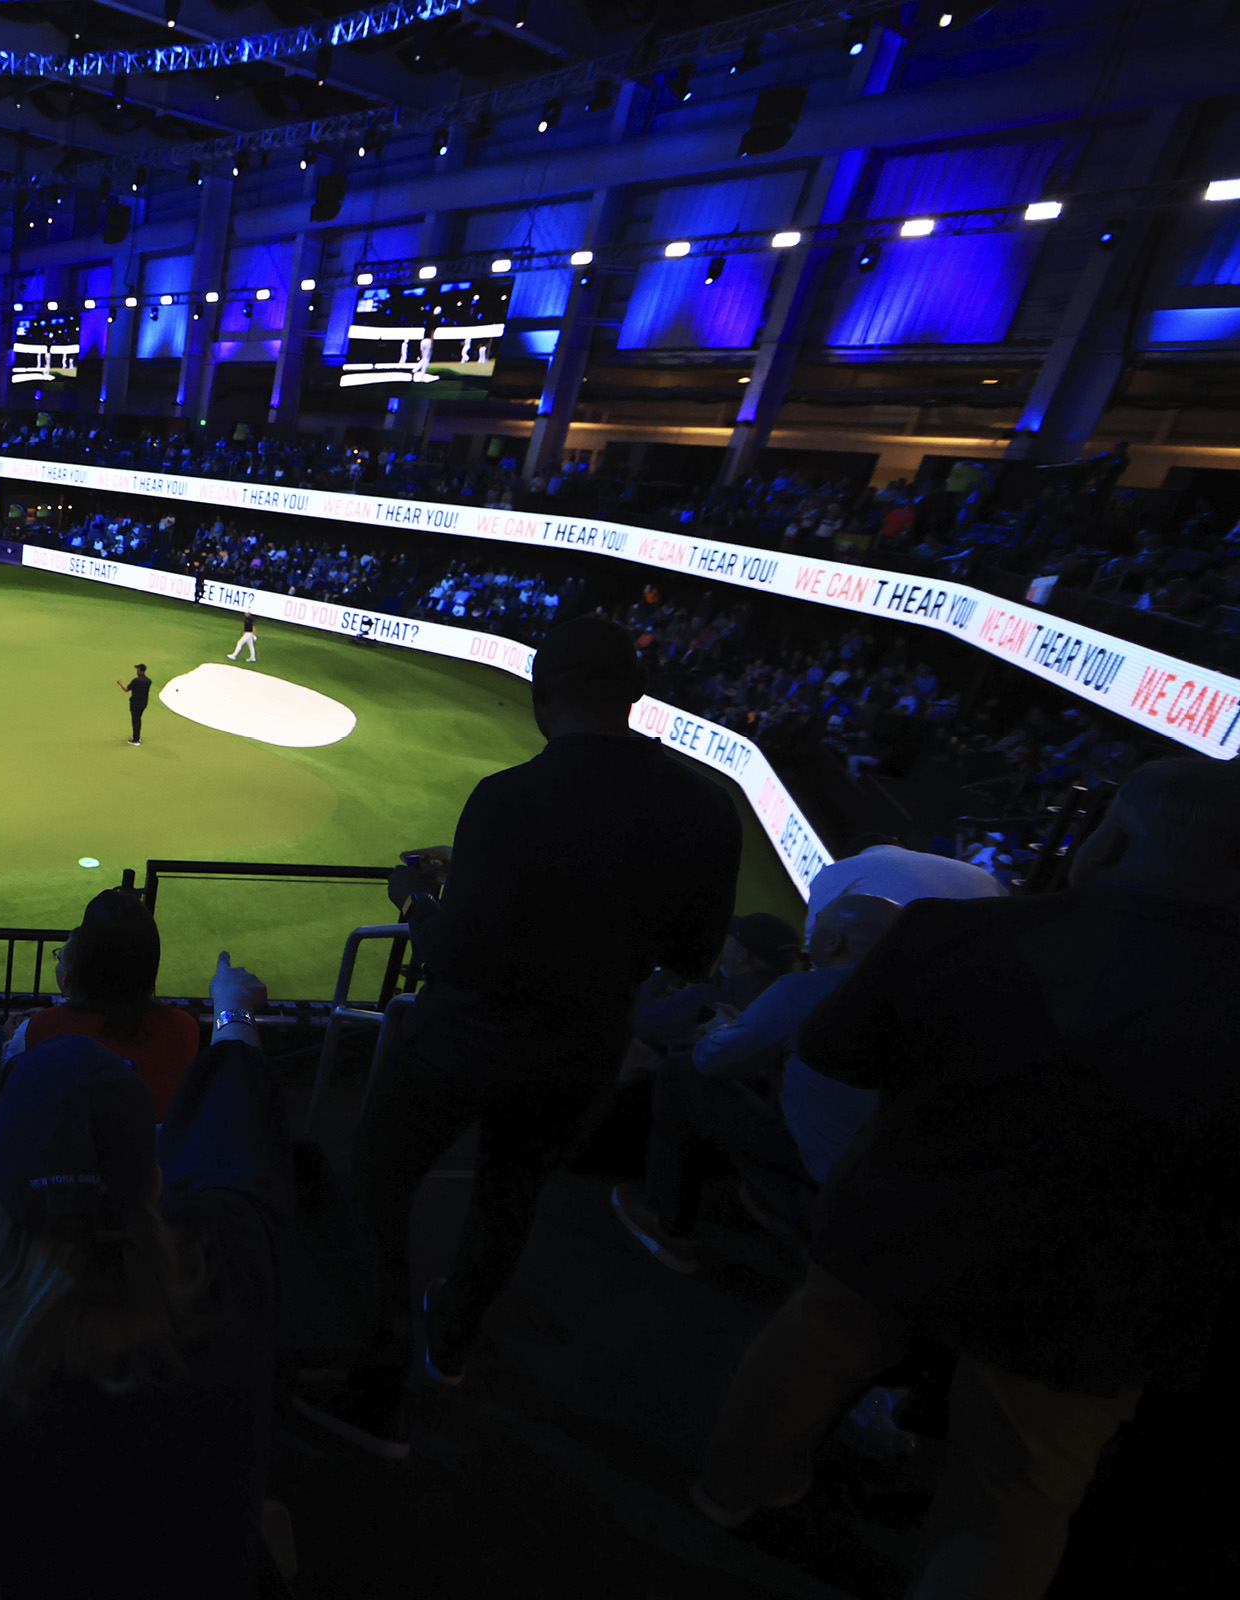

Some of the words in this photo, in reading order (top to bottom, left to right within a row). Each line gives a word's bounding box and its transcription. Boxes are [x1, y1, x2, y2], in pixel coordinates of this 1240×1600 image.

[139, 477, 164, 493] HEAR
[166, 479, 188, 497] YOU!
[249, 488, 280, 507] HEAR
[282, 492, 310, 512] YOU!
[322, 498, 342, 517] WE
[344, 501, 383, 520] CAN'T
[385, 504, 421, 525] HEAR
[426, 509, 460, 529] YOU!
[476, 514, 499, 535] WE
[503, 517, 552, 541] CAN'T
[554, 523, 598, 547] HEAR
[600, 529, 628, 553] YOU!
[69, 557, 86, 574] SEE
[89, 561, 118, 581] THAT?
[638, 536, 659, 560] WE
[659, 540, 700, 567] CAN'T
[697, 548, 739, 576] HEAR
[739, 555, 779, 585] YOU!
[148, 573, 167, 591] DID
[170, 578, 191, 597] YOU
[219, 586, 255, 610] THAT?
[795, 565, 826, 594] WE
[825, 572, 891, 607] CAN'T
[886, 583, 948, 620] HEAR
[943, 592, 978, 631] YOU!
[283, 599, 306, 622] DID
[311, 606, 338, 627] YOU
[373, 617, 420, 643] THAT?
[469, 636, 499, 662] DID
[502, 643, 524, 671] YOU
[979, 606, 1006, 643] WE
[997, 612, 1045, 659] CAN'T
[1033, 628, 1084, 677] HEAR
[1075, 642, 1127, 695] YOU!
[1131, 665, 1178, 717] WE
[638, 701, 670, 735] YOU
[669, 716, 705, 752] SEE
[705, 730, 752, 777] THAT?
[793, 833, 827, 889] THAT
